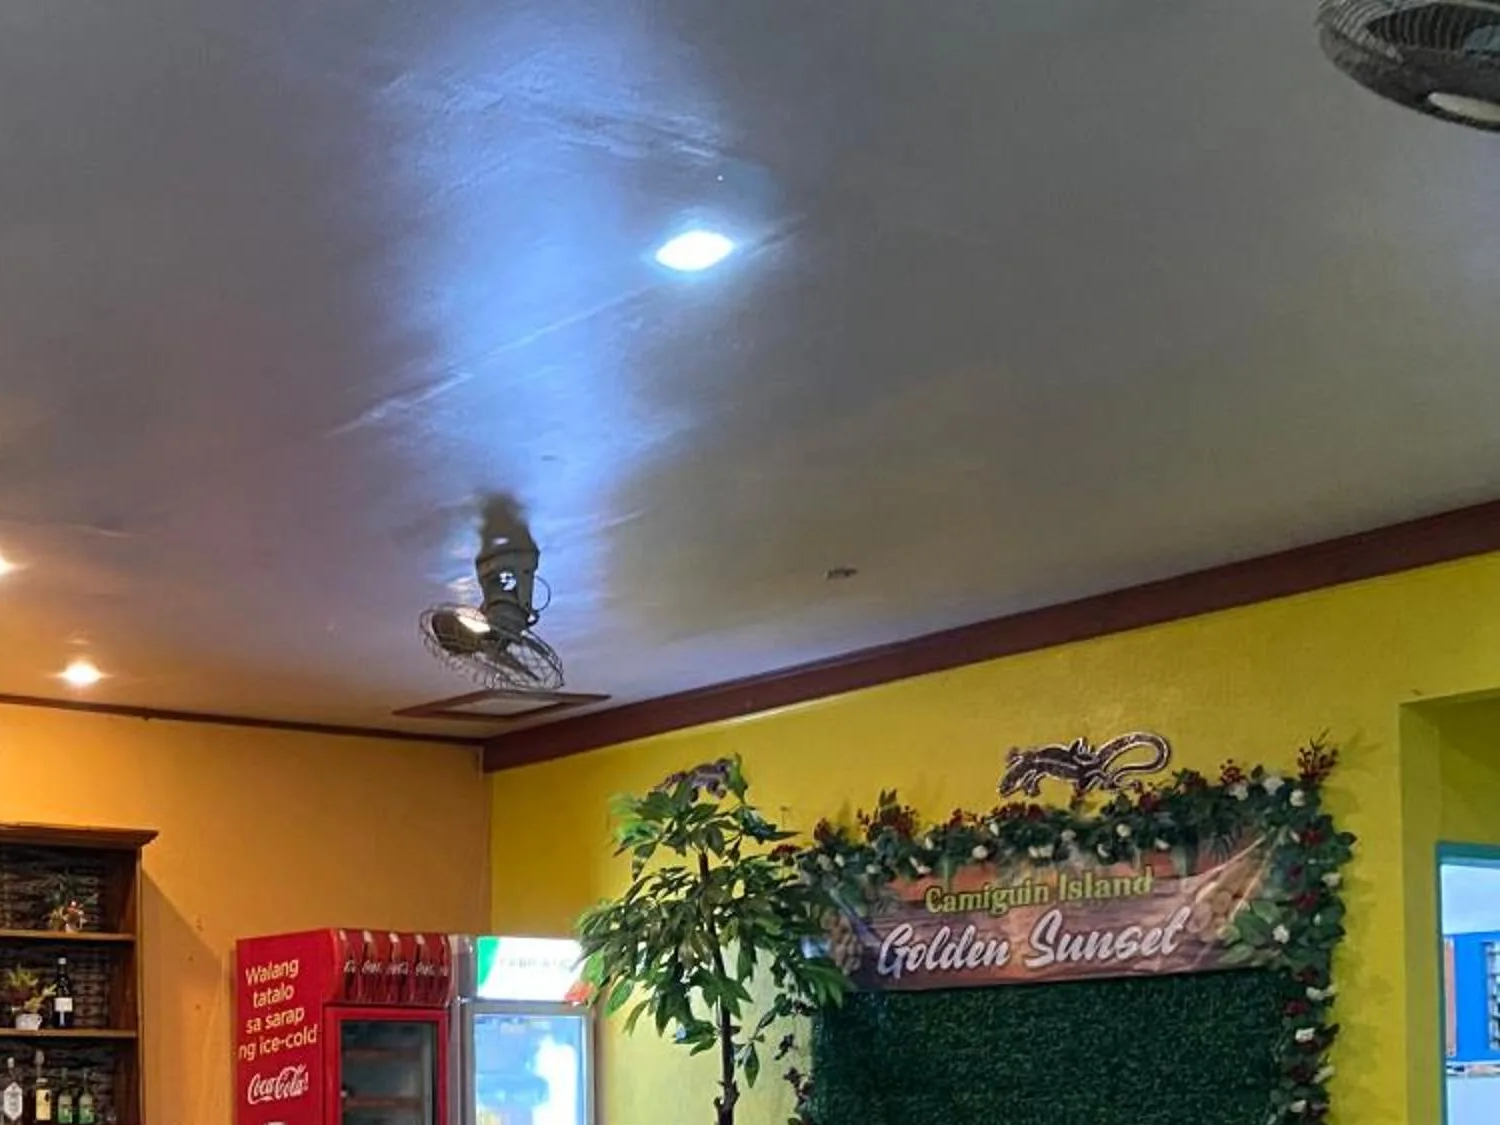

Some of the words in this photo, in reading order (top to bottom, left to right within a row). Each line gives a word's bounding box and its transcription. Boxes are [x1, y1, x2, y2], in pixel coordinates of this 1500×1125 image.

[925, 878, 1050, 914] Camiguin
[1059, 865, 1154, 901] Island
[878, 923, 1009, 977] Golden
[245, 958, 299, 986] Walang
[253, 983, 295, 1009] tatalo
[246, 1016, 261, 1034] sa
[265, 1007, 305, 1030] sarap
[239, 1041, 257, 1061] ng
[259, 1024, 318, 1055] ice-cold
